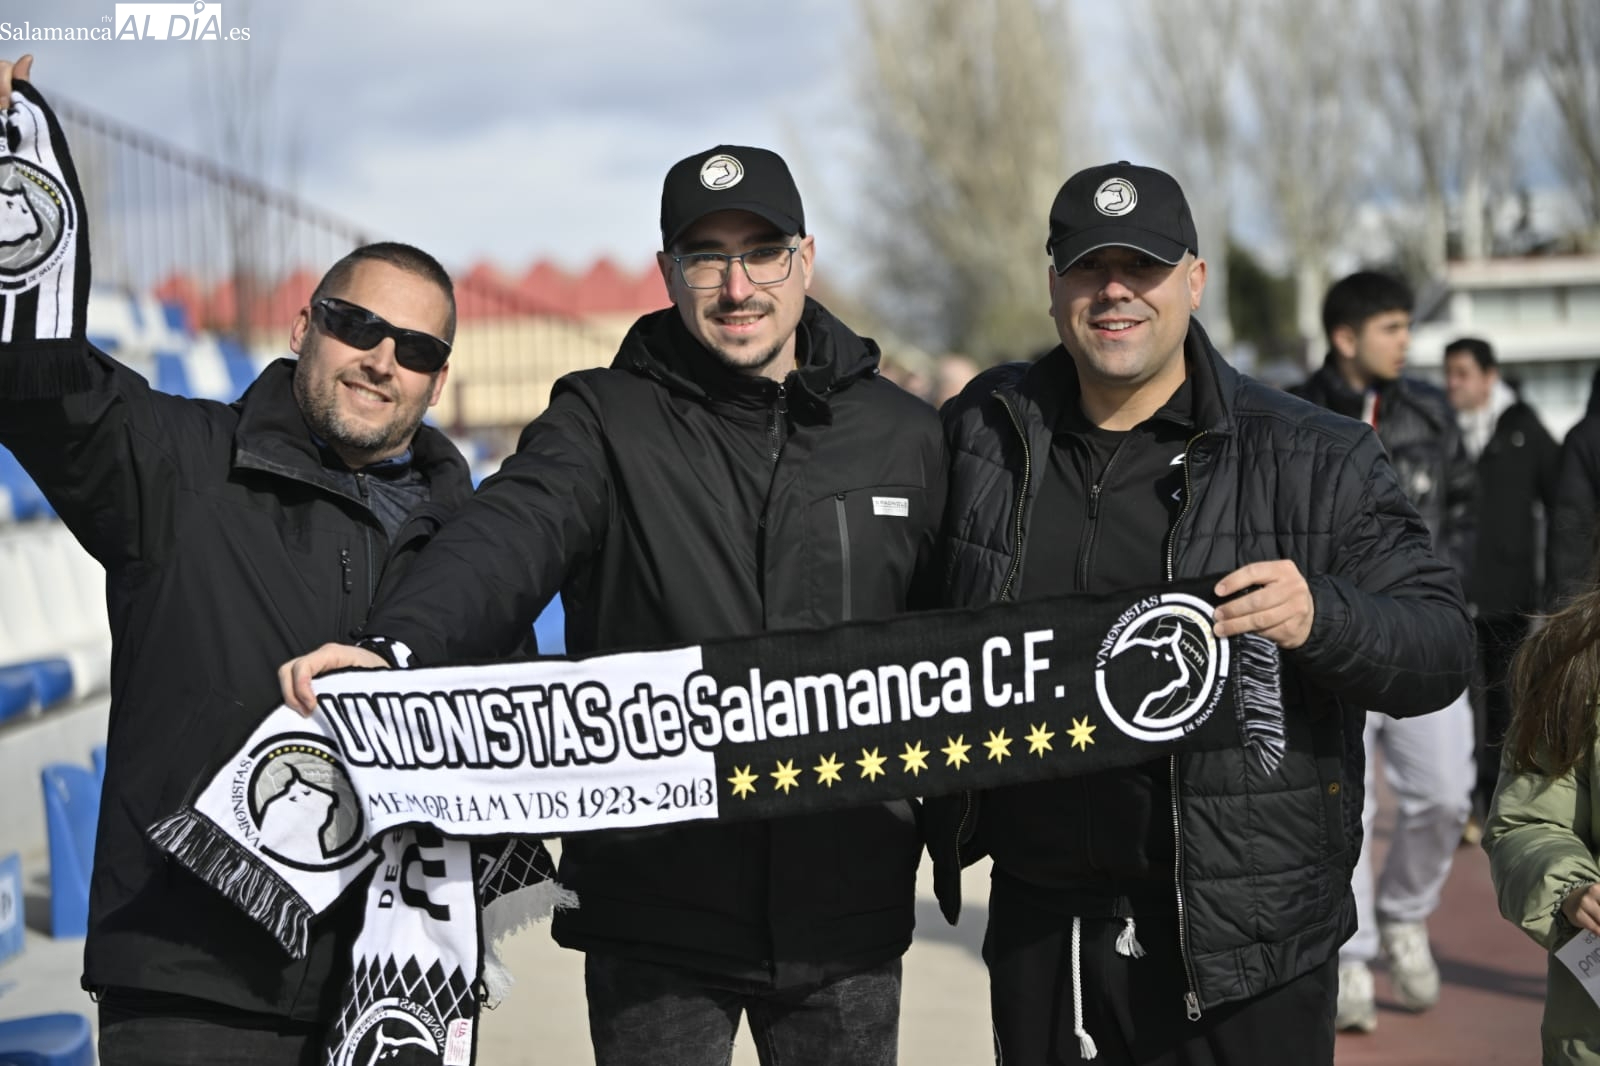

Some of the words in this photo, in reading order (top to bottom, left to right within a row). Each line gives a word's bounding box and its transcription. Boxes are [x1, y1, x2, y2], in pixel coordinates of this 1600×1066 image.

[317, 681, 619, 770] UNIONISTAS
[620, 683, 686, 760] de
[686, 656, 972, 750] Salamanca
[982, 629, 1065, 708] C.F.
[512, 790, 569, 820] VDS
